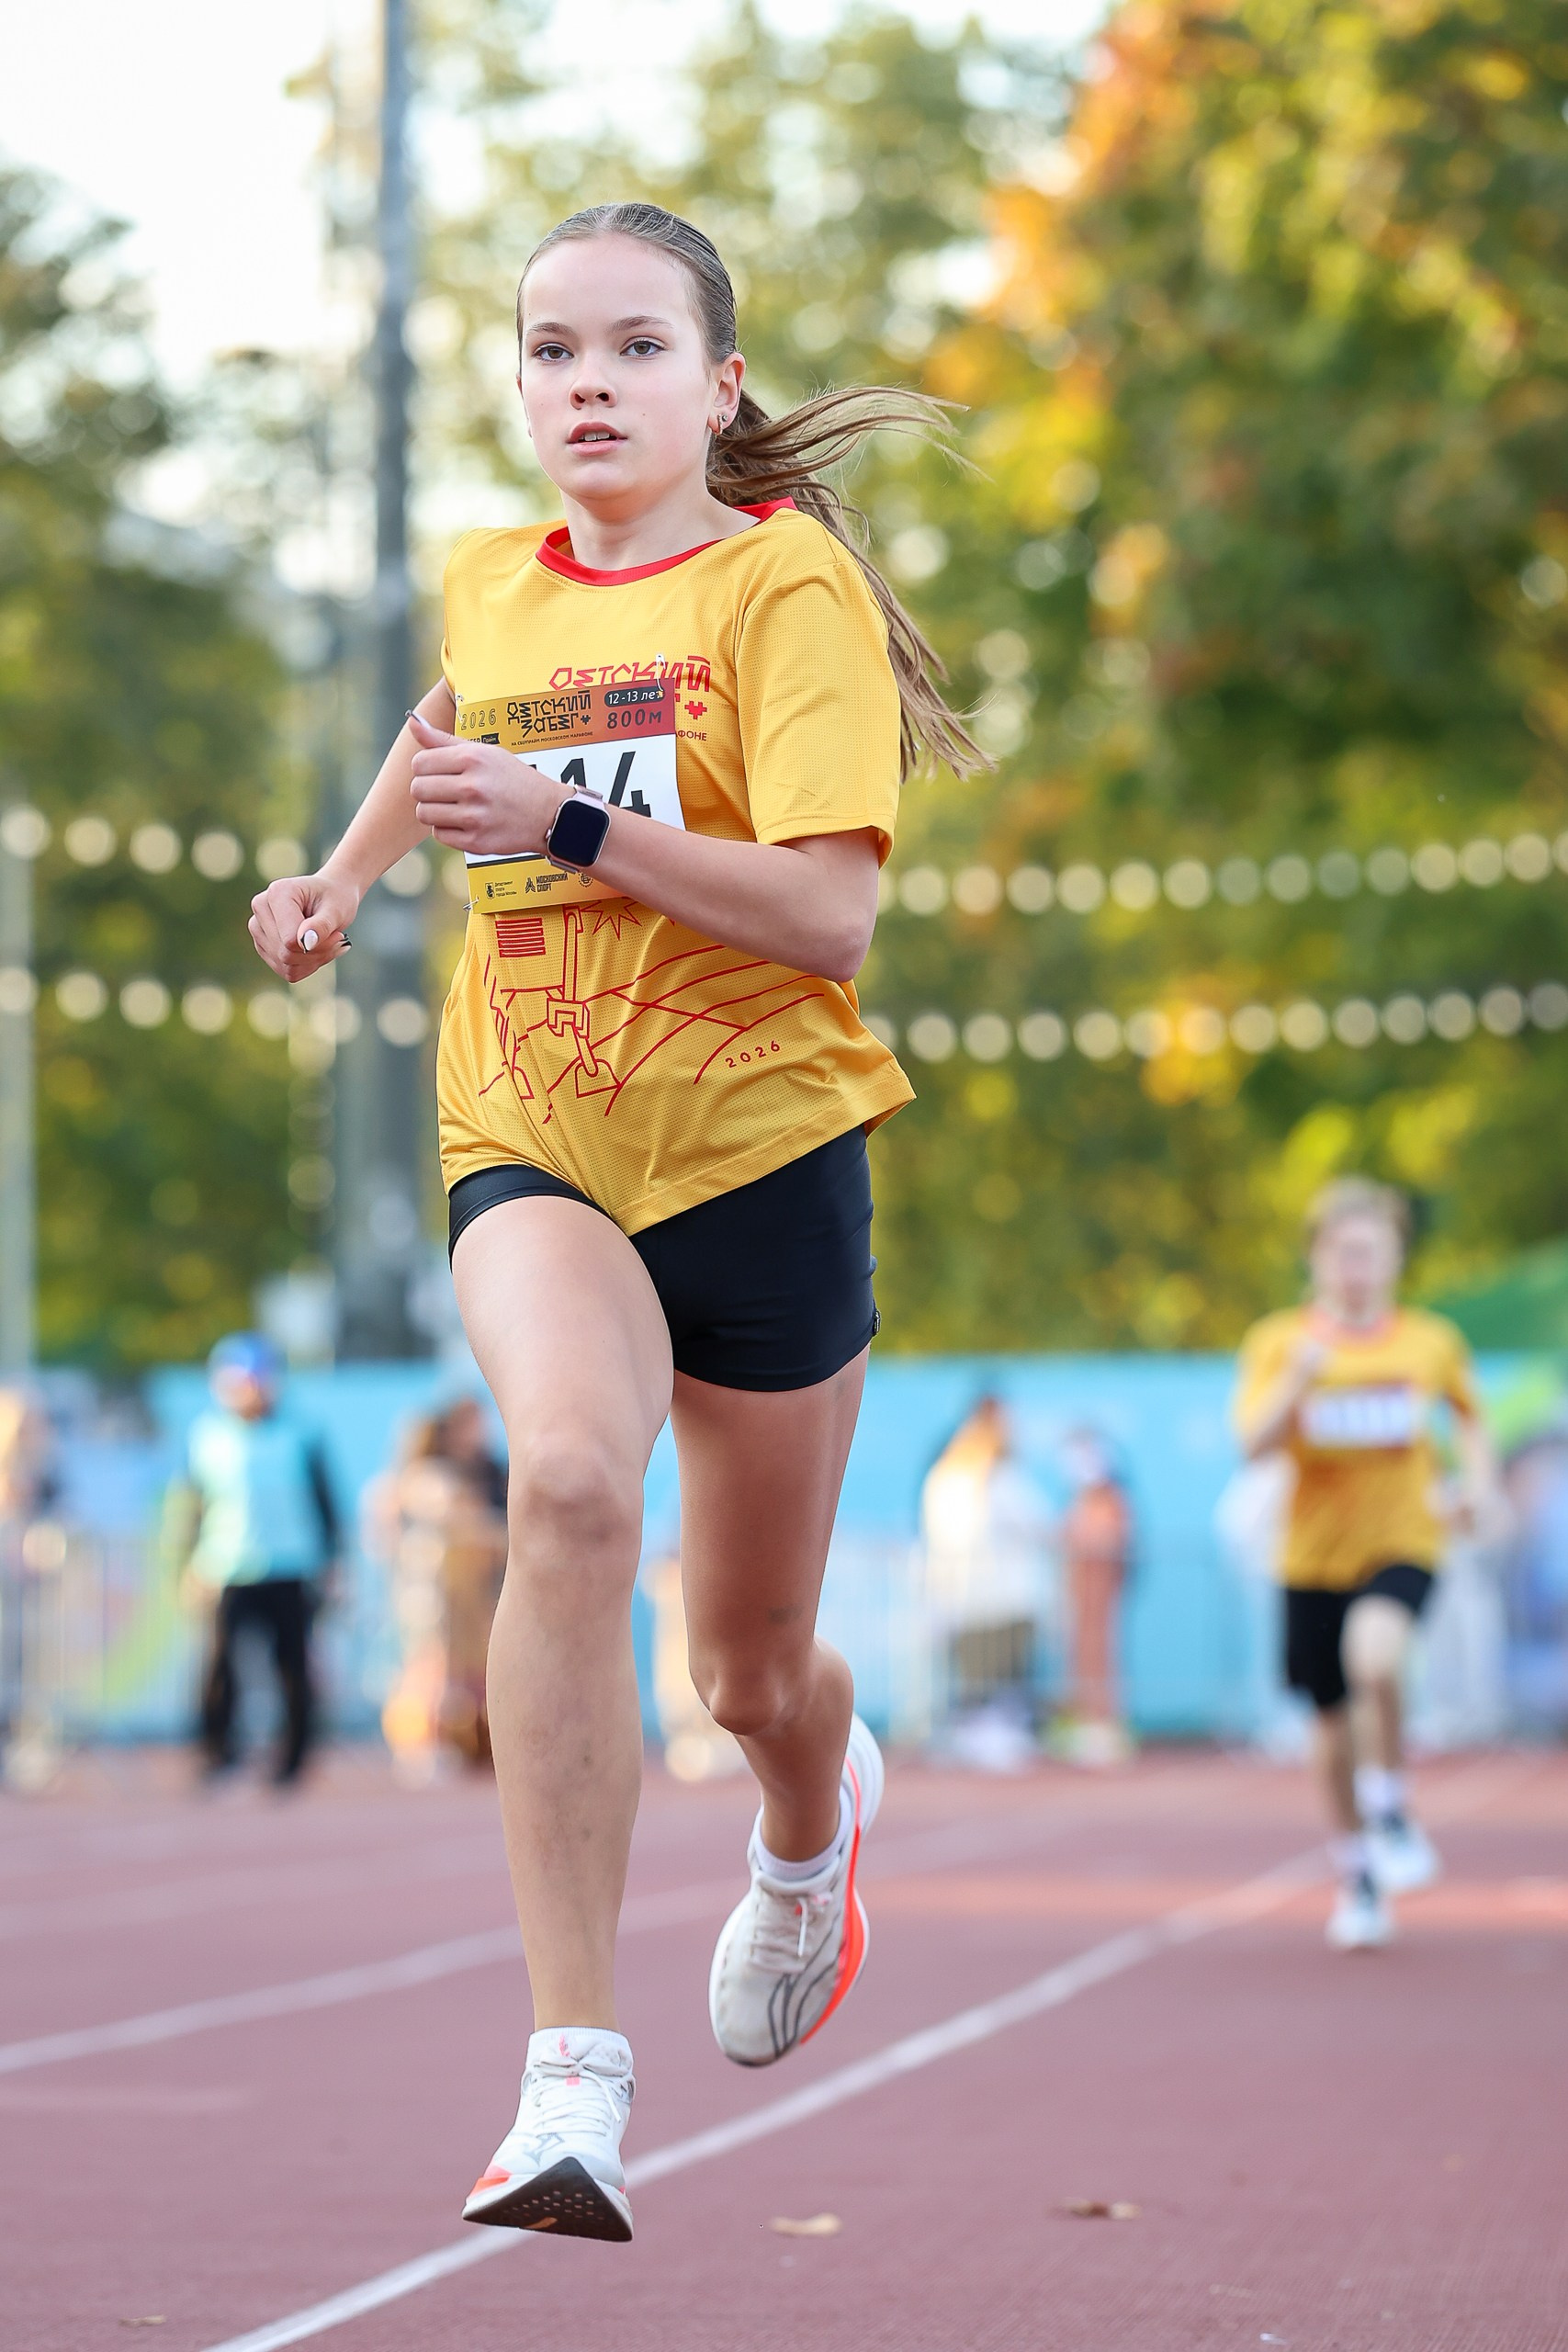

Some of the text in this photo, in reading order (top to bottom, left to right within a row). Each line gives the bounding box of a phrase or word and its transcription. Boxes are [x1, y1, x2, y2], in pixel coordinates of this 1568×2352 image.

[461, 708, 497, 730] 2026
[507, 690, 591, 725] ДЕТСКИЙ
[521, 713, 579, 738] ЗАБЕГ
[675, 730, 707, 741] ФОНЕ
[725, 1040, 780, 1068] 2026
